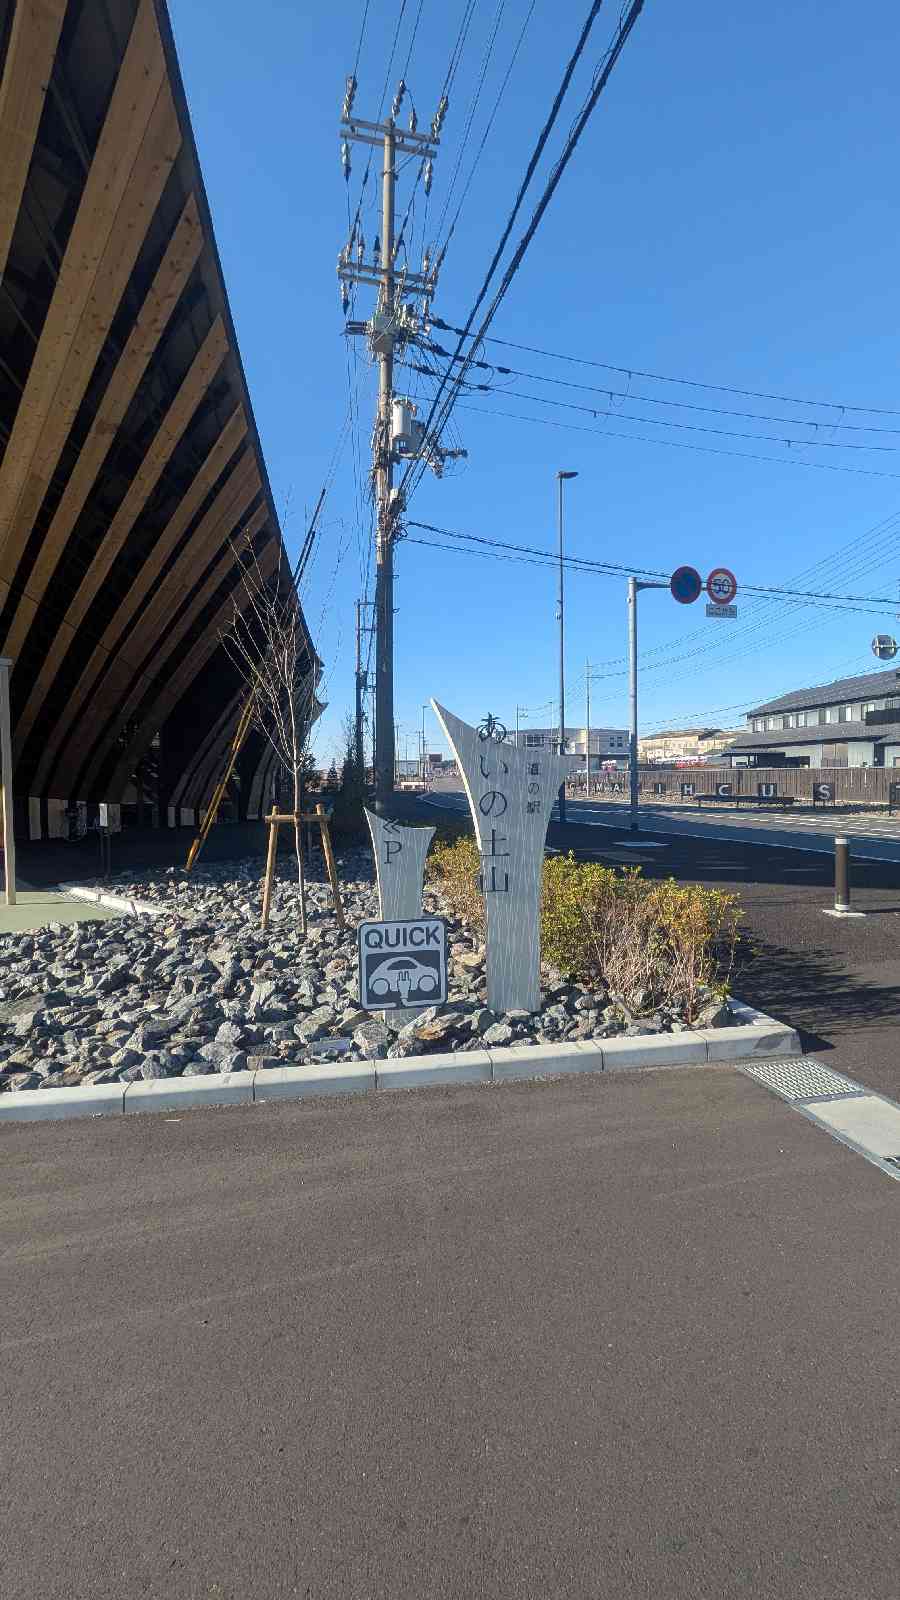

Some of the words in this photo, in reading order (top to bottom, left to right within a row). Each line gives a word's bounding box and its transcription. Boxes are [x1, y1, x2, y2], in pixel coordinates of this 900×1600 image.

[478, 712, 511, 892] あいの土山
[526, 762, 541, 814] 道の駅
[383, 840, 403, 865] P
[364, 926, 441, 949] QUICK
